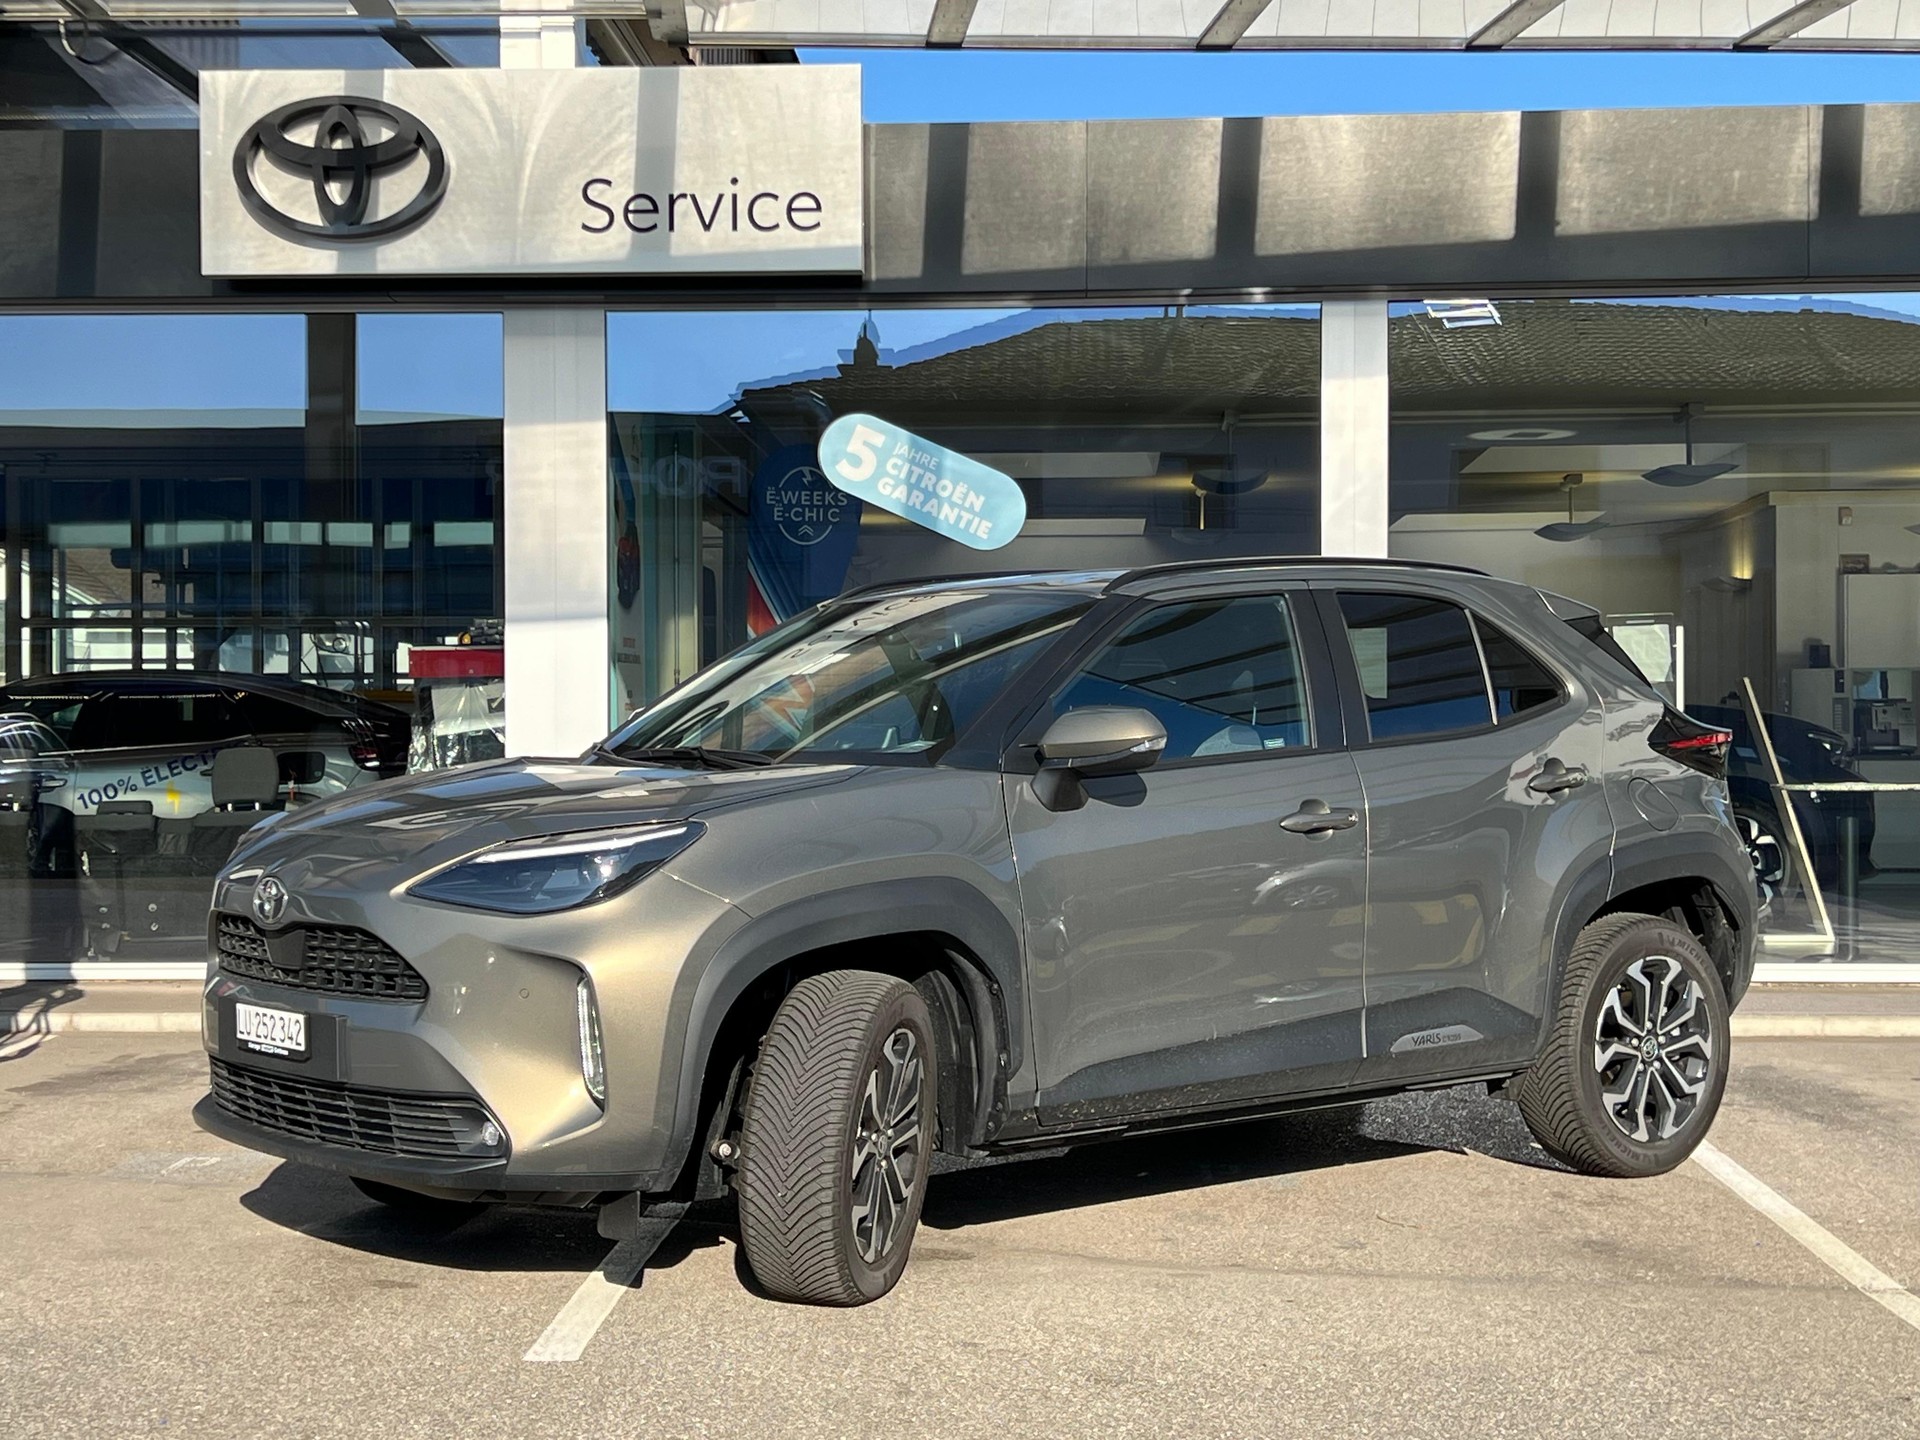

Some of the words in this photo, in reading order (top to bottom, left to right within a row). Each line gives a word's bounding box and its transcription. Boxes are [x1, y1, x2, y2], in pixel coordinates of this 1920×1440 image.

[581, 176, 823, 234] Service
[835, 423, 886, 482] 5
[893, 442, 940, 470] JAHRE
[766, 486, 848, 506] Ë-WEEKS
[886, 457, 986, 513] CITROËN
[773, 503, 840, 522] Ë-CHIC
[877, 477, 993, 540] GARANTIE
[77, 775, 138, 810] 100%
[238, 1008, 252, 1036] LU
[1411, 1033, 1442, 1047] YARIS
